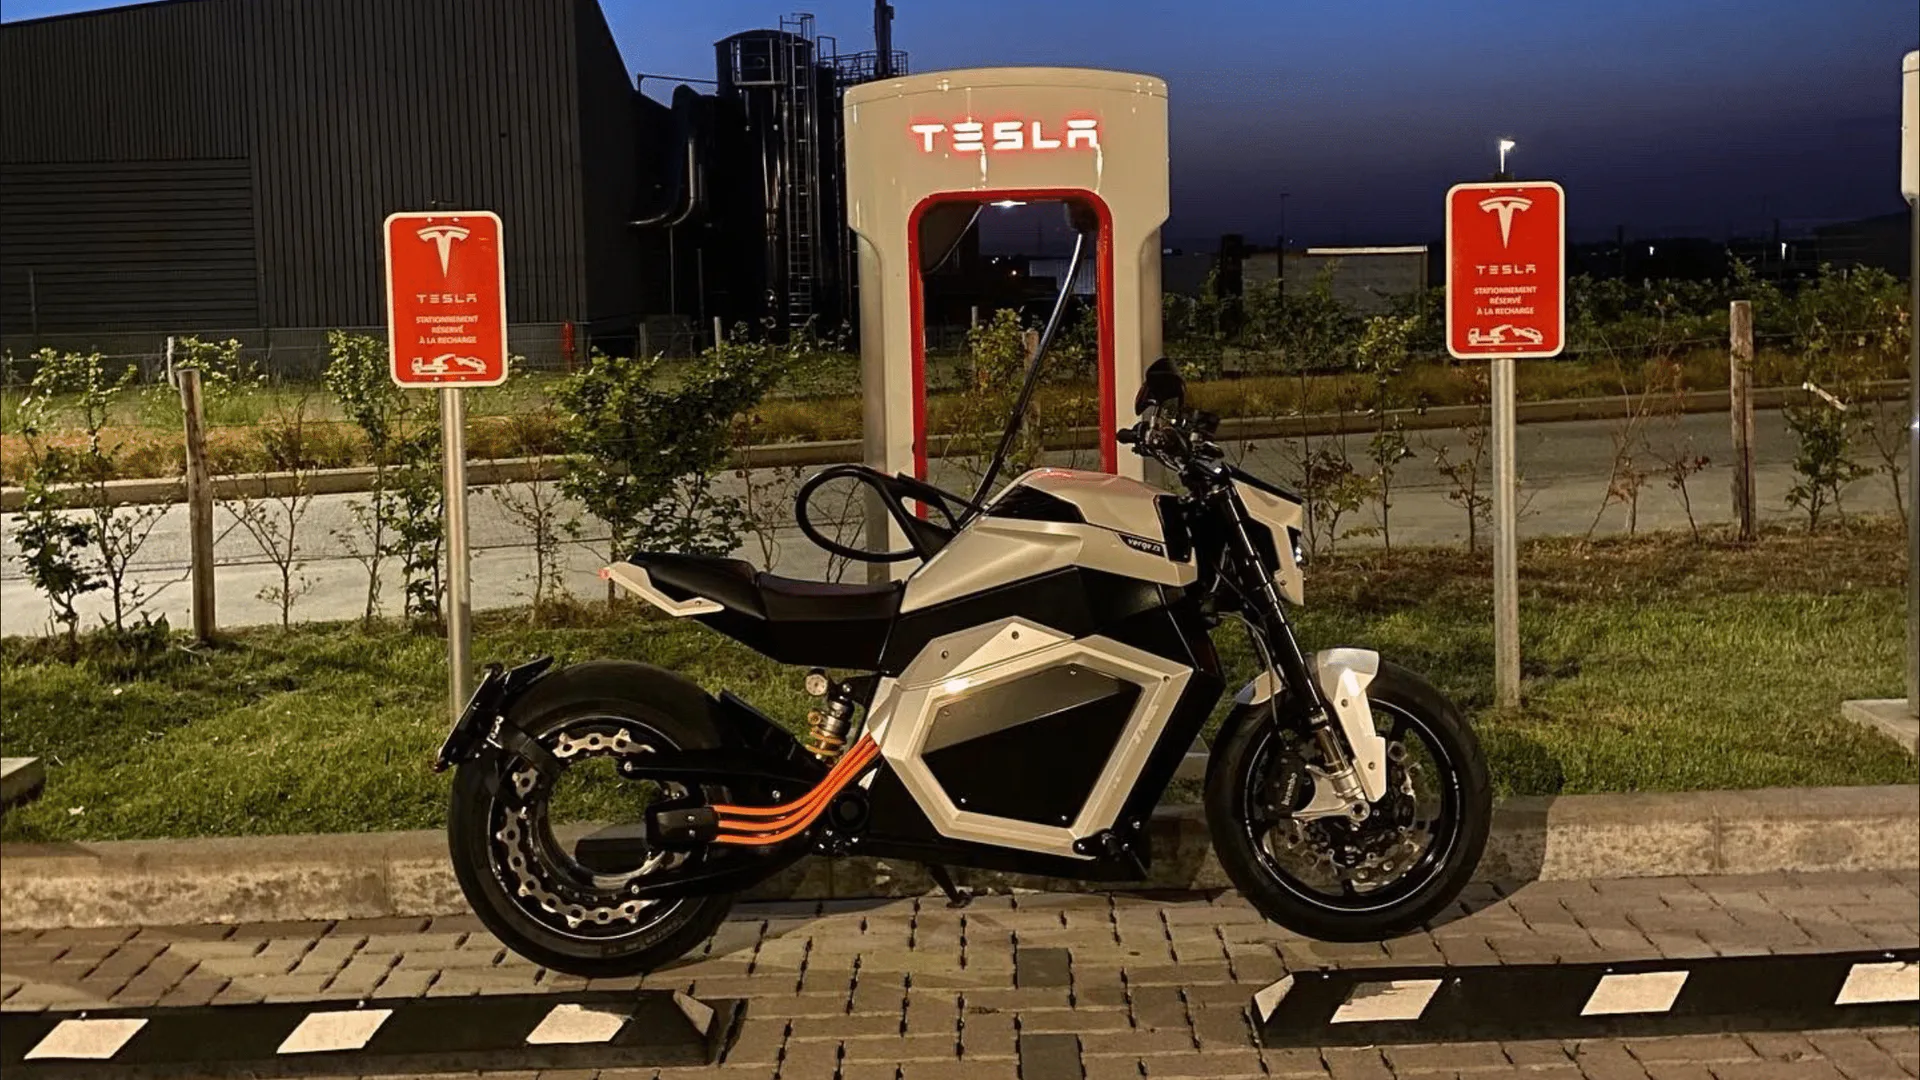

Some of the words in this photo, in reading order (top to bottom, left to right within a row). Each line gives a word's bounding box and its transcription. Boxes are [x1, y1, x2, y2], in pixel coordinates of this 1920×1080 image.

[911, 119, 1099, 152] TESLA
[1476, 264, 1536, 275] TESLA
[1474, 286, 1537, 295] STATIONNEMENT
[416, 293, 477, 304] TESLA
[1495, 307, 1534, 315] RECHARGE
[437, 336, 477, 344] RECHARGE
